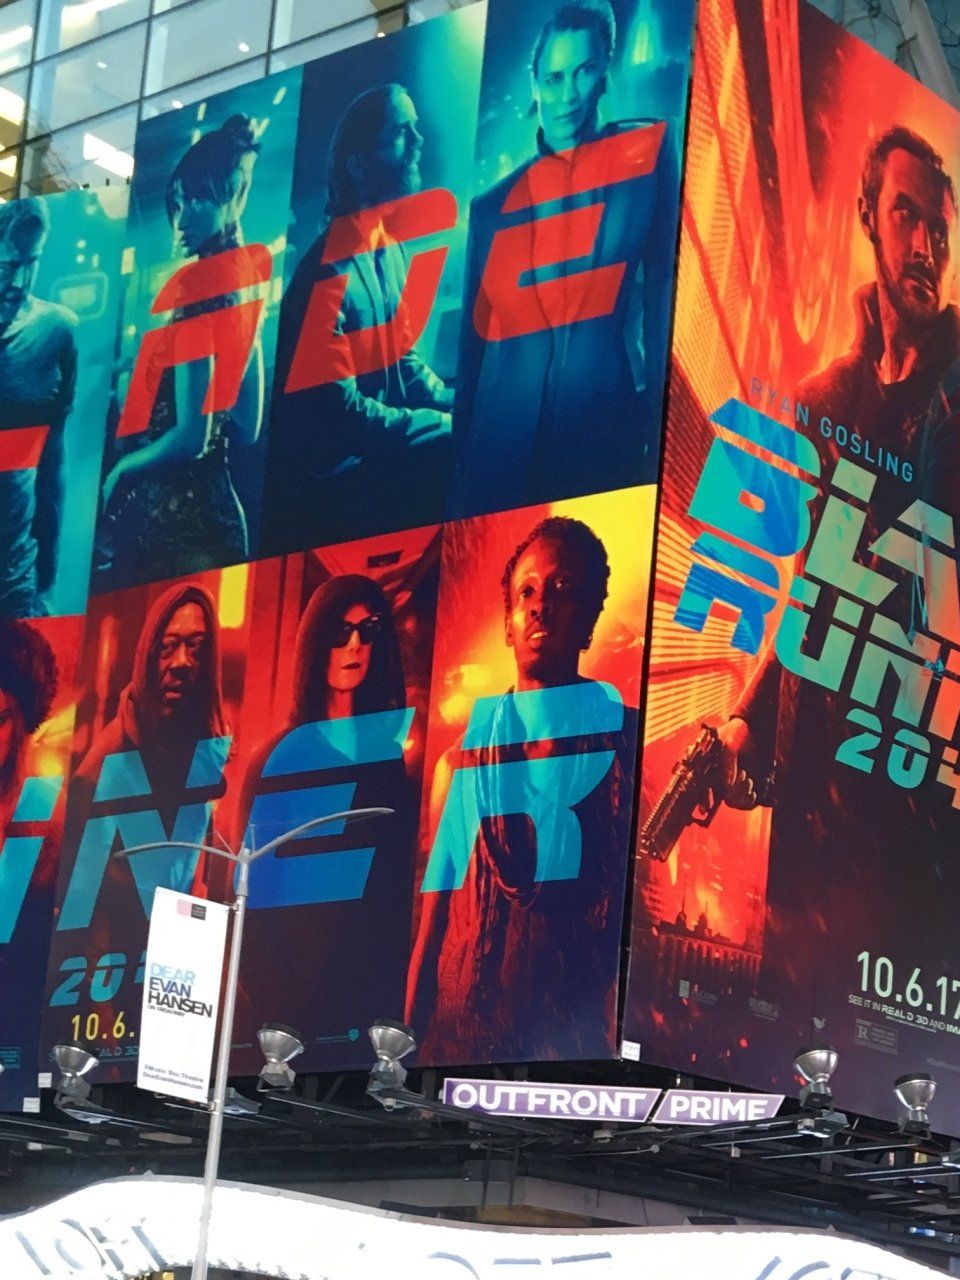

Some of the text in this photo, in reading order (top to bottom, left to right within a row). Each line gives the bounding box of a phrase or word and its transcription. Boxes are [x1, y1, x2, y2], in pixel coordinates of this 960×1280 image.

[750, 376, 914, 483] RYAN GOSLING
[151, 962, 196, 985] DEAR
[149, 976, 191, 998] EVAN
[148, 990, 213, 1018] HANSEN
[849, 995, 863, 1007] SEE
[864, 999, 871, 1008] IT
[872, 1002, 881, 1012] IN
[857, 1025, 869, 1041] R
[452, 1083, 768, 1121] OUTFRONT PRIME
